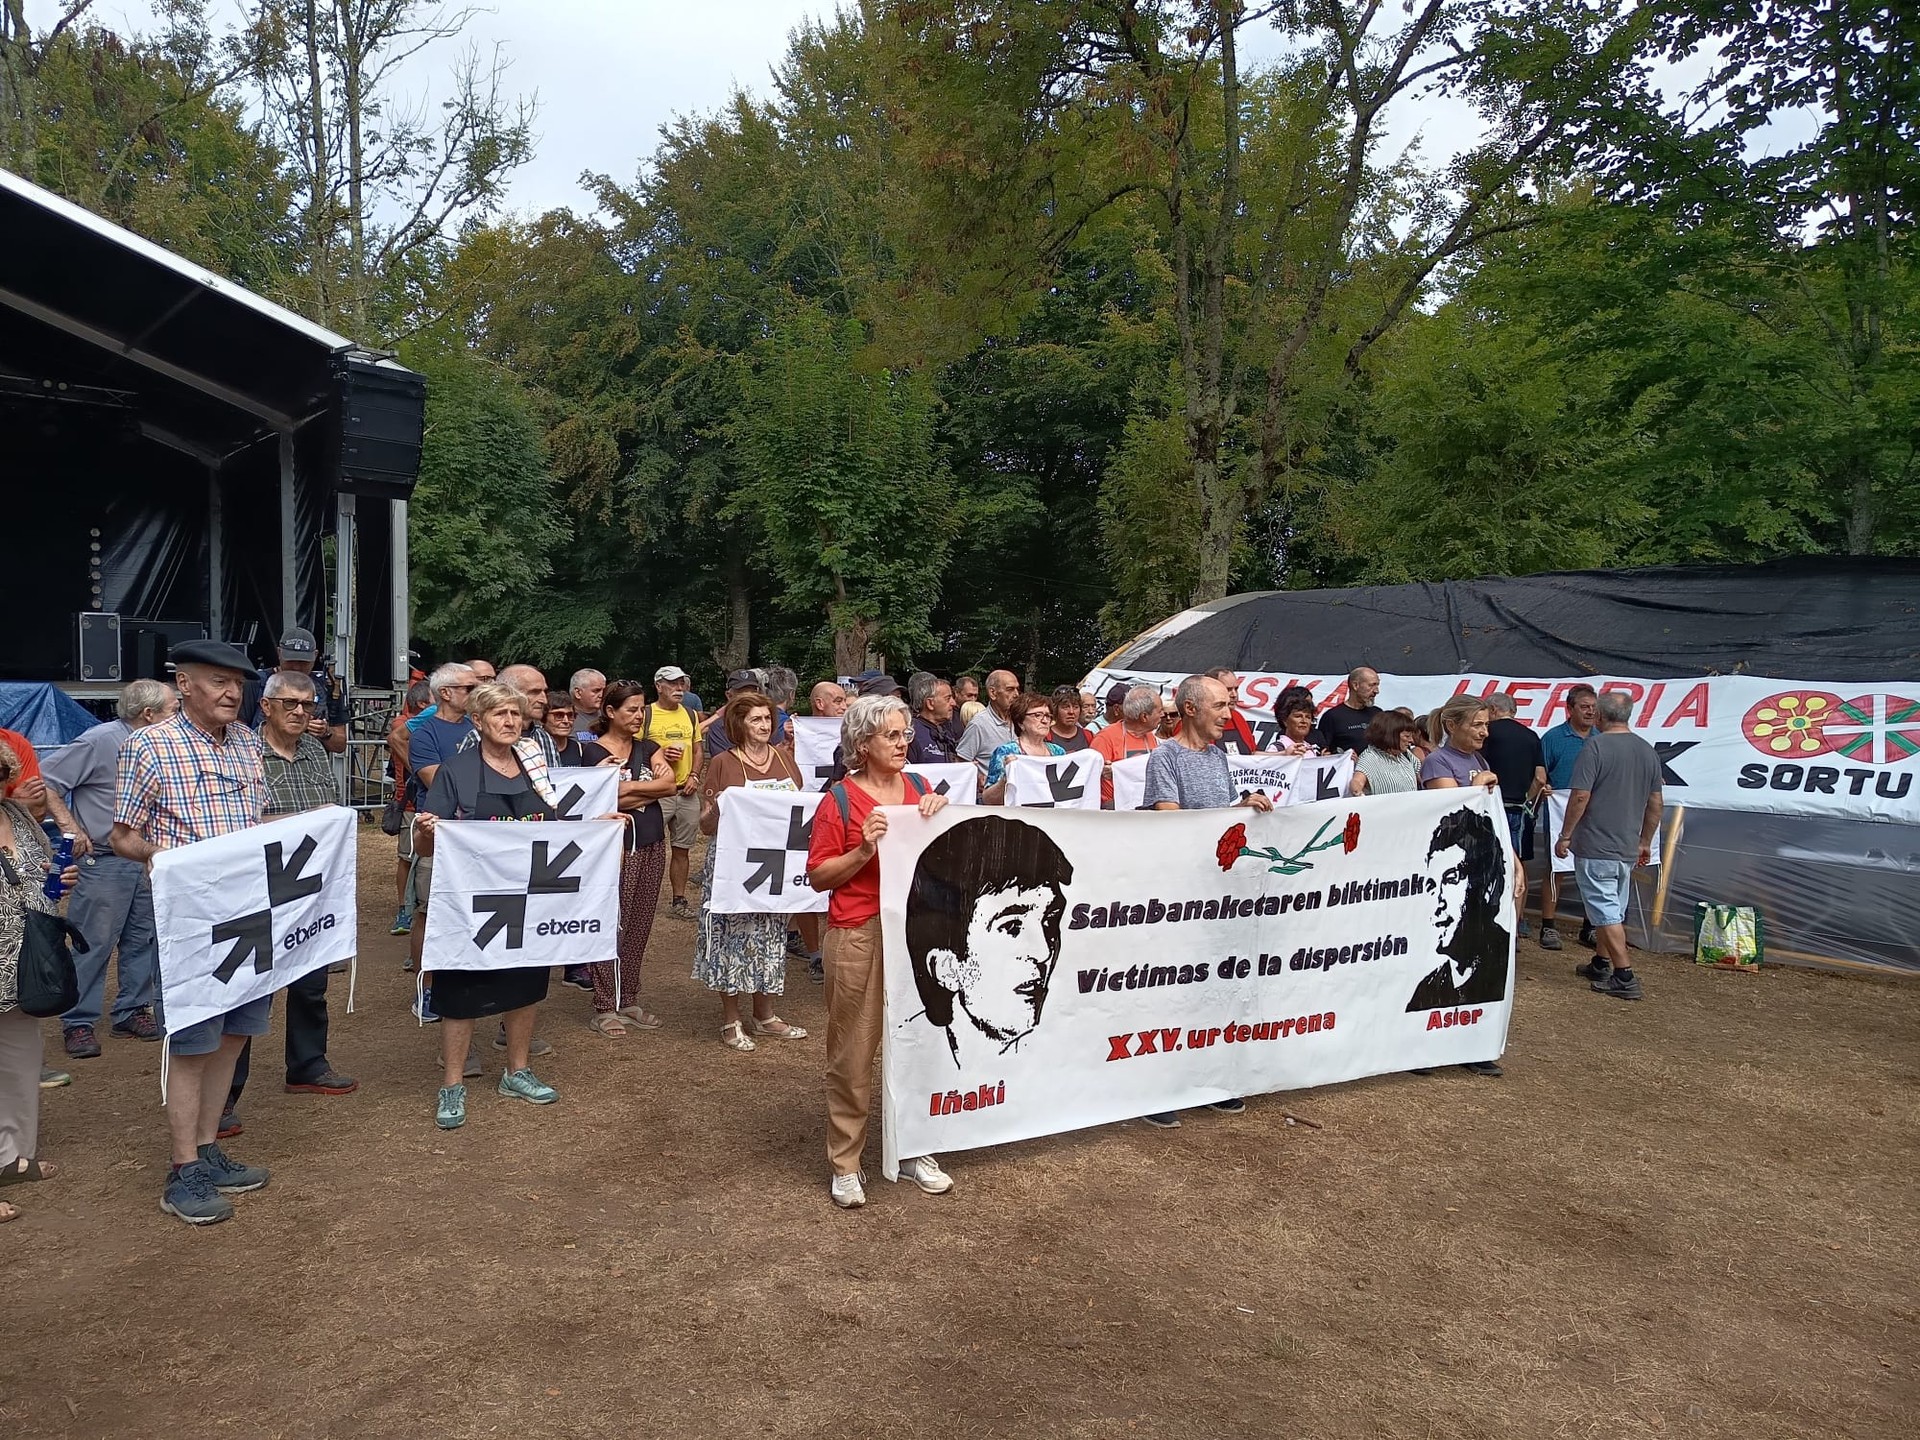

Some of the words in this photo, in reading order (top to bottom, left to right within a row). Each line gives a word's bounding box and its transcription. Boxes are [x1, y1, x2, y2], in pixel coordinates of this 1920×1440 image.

[1240, 776, 1291, 790] IHESLARIAK
[1260, 769, 1286, 781] PRESO
[1737, 763, 1913, 799] SORTU
[1068, 890, 1322, 930] Sakabanaketaren
[1326, 874, 1425, 907] biktimak
[284, 913, 335, 950] etxera
[536, 918, 601, 936] etxera
[1217, 956, 1252, 979] de
[1258, 953, 1282, 977] la
[1289, 935, 1408, 972] dispersión
[1426, 1007, 1483, 1031] Asier
[930, 1079, 1006, 1116] Iñaki
